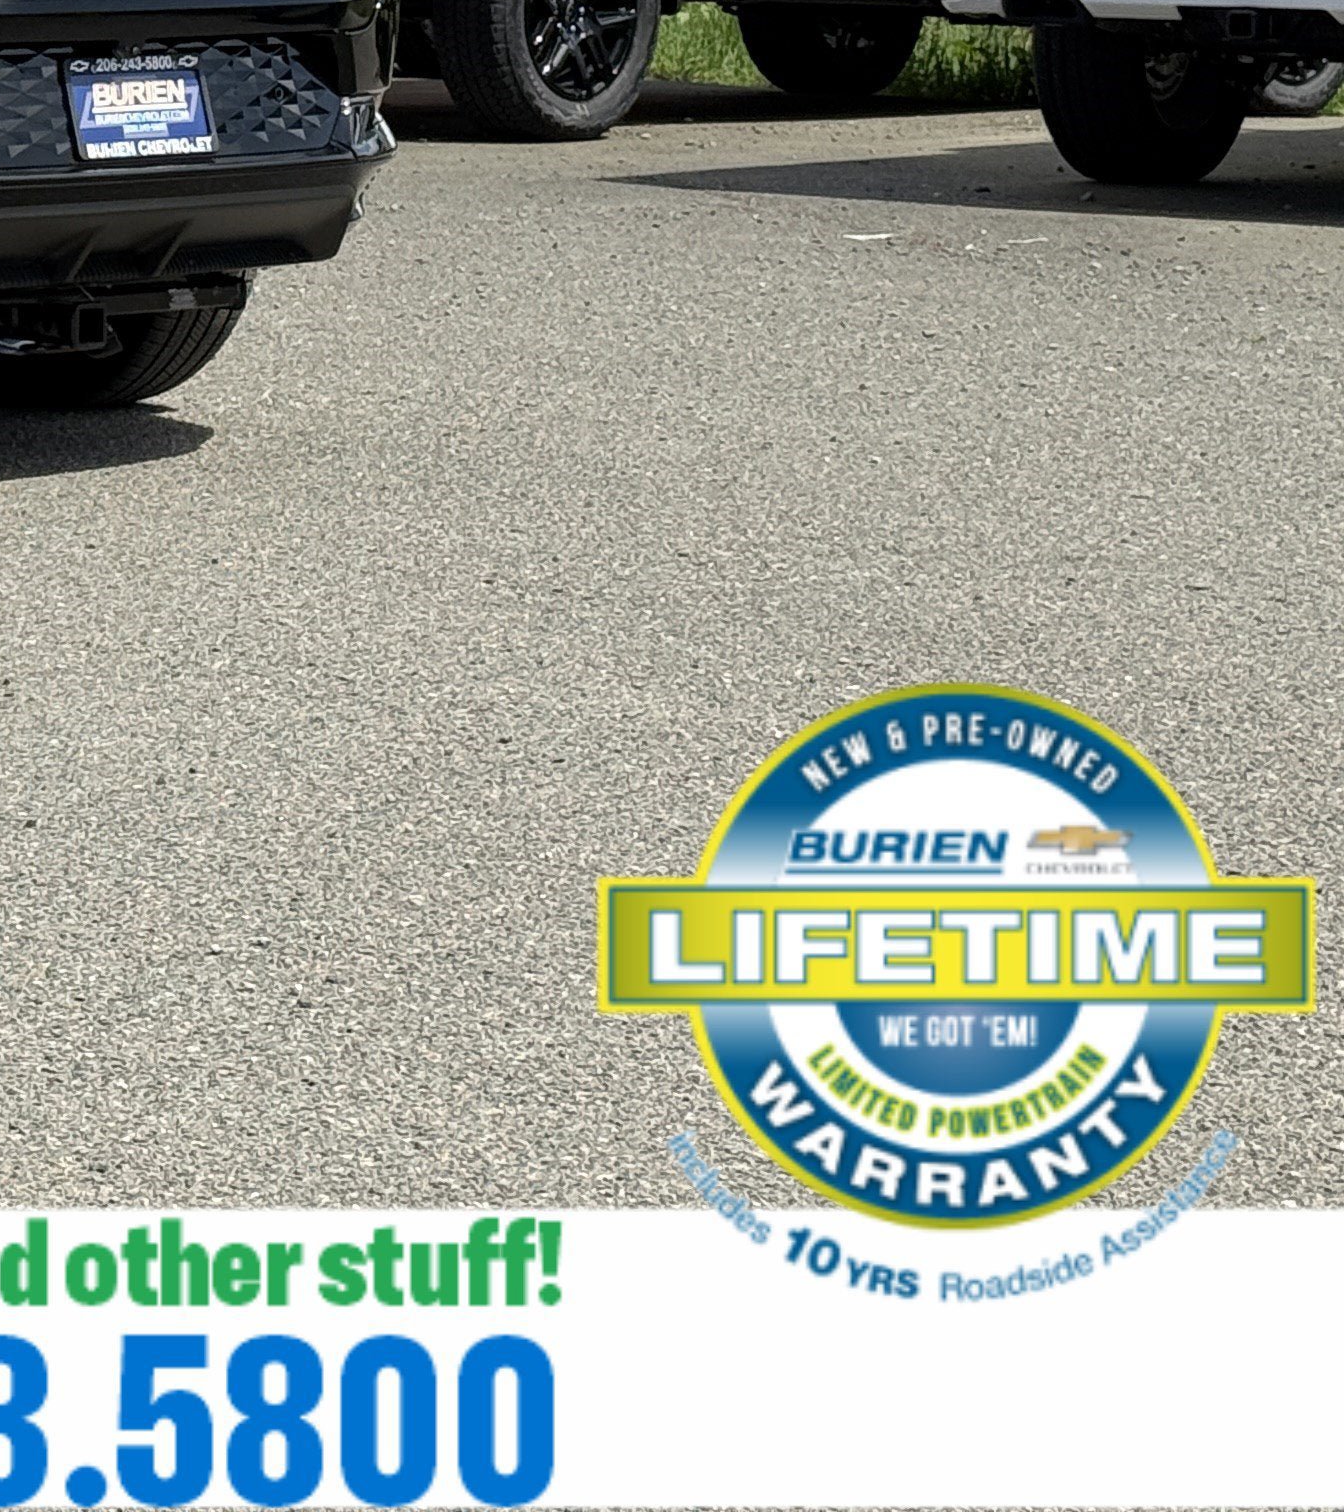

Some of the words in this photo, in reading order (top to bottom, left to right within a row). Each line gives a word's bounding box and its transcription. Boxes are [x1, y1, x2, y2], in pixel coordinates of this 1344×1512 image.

[91, 78, 186, 107] BURIEN
[86, 140, 138, 160] BURIEN
[137, 135, 213, 157] CHEVROLET
